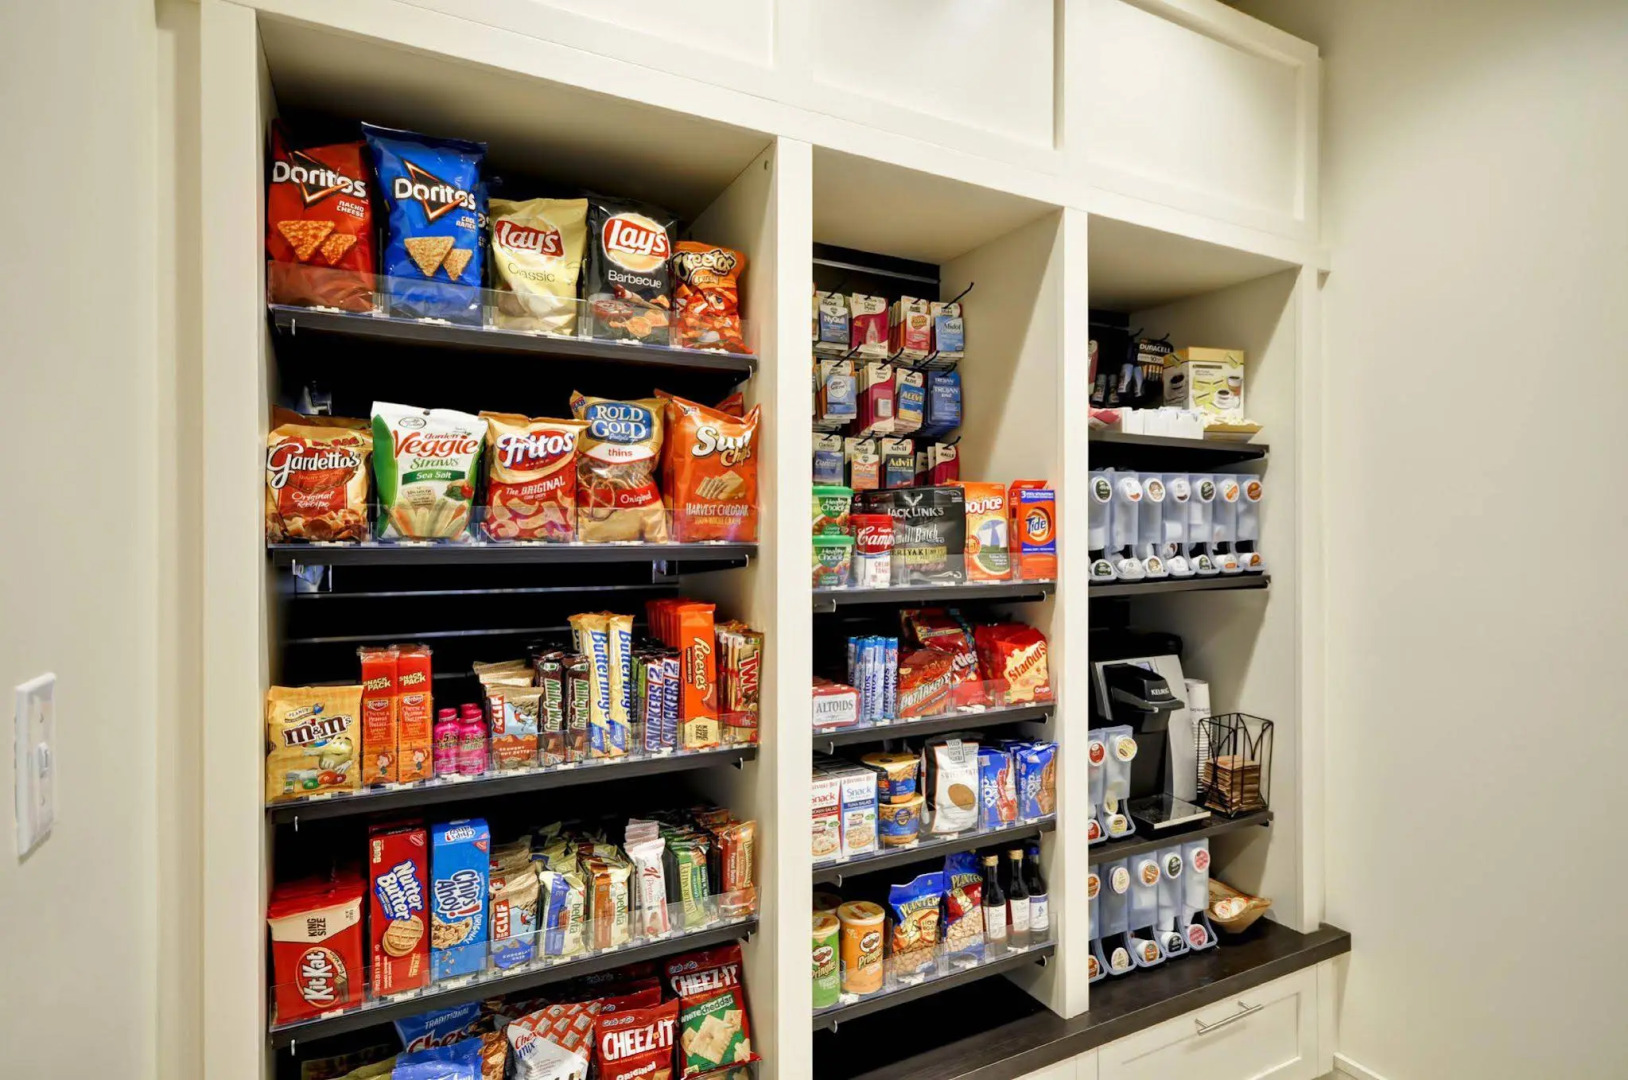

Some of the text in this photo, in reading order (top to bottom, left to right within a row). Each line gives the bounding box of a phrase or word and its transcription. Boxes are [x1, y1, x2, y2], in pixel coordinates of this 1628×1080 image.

[272, 161, 367, 198] Doritos
[395, 178, 476, 211] Doritos
[500, 220, 560, 254] Lay's
[607, 220, 667, 254] Lay's
[608, 270, 662, 288] Barbecue
[1139, 342, 1171, 354] DURACELL
[594, 404, 643, 420] ROLD
[592, 420, 646, 439] GOLD
[393, 430, 478, 458] Veggie
[497, 429, 575, 468] Fritos
[692, 425, 752, 457] Sun
[890, 444, 907, 452] Advil
[410, 456, 459, 468] Straws
[608, 448, 633, 457] thins
[267, 441, 361, 489] Gardetto's
[888, 457, 914, 468] Advil
[416, 470, 451, 479] Sea Salt
[505, 475, 565, 496] The ORIGINAL
[1021, 490, 1028, 499] 3
[291, 490, 335, 503] Original
[620, 492, 653, 505] Original
[685, 502, 716, 516] HARVEST
[820, 503, 846, 511] Choice
[888, 508, 944, 518] JACK LINK'S
[895, 524, 939, 544] mall Batch
[1025, 518, 1047, 531] Tide
[819, 554, 844, 562] Choice
[821, 548, 847, 556] Healthy
[890, 547, 928, 557] ERIYAKI
[664, 661, 673, 675] 2
[693, 637, 711, 691] Reese's
[363, 676, 387, 685] SNACK
[399, 671, 424, 682] SNACK
[403, 675, 427, 686] PACK
[649, 667, 659, 681] 2
[367, 680, 391, 691] PACK
[491, 697, 504, 727] CLIF
[544, 678, 563, 732] Milky Way
[572, 679, 590, 730] Milky Way
[662, 677, 680, 746] SNICKERS
[816, 700, 854, 714] ALTOIDS
[646, 682, 664, 751] SNICKERS
[285, 715, 352, 746] m&m's
[846, 787, 872, 797] Snack
[393, 860, 424, 911] Nutter
[451, 870, 480, 906] Chips
[376, 871, 411, 920] Butter
[307, 918, 317, 937] KING
[317, 918, 327, 936] SIZE
[496, 903, 509, 933] CLIF
[463, 914, 483, 945] ORIGINAL
[857, 949, 883, 970] Pringl
[670, 964, 739, 994] CHEEZ-IT
[701, 994, 734, 1018] cheddar
[425, 1007, 469, 1030] TRADITIONAL
[514, 1030, 539, 1047] Chex
[602, 1019, 675, 1061] CHEEZ-IT
